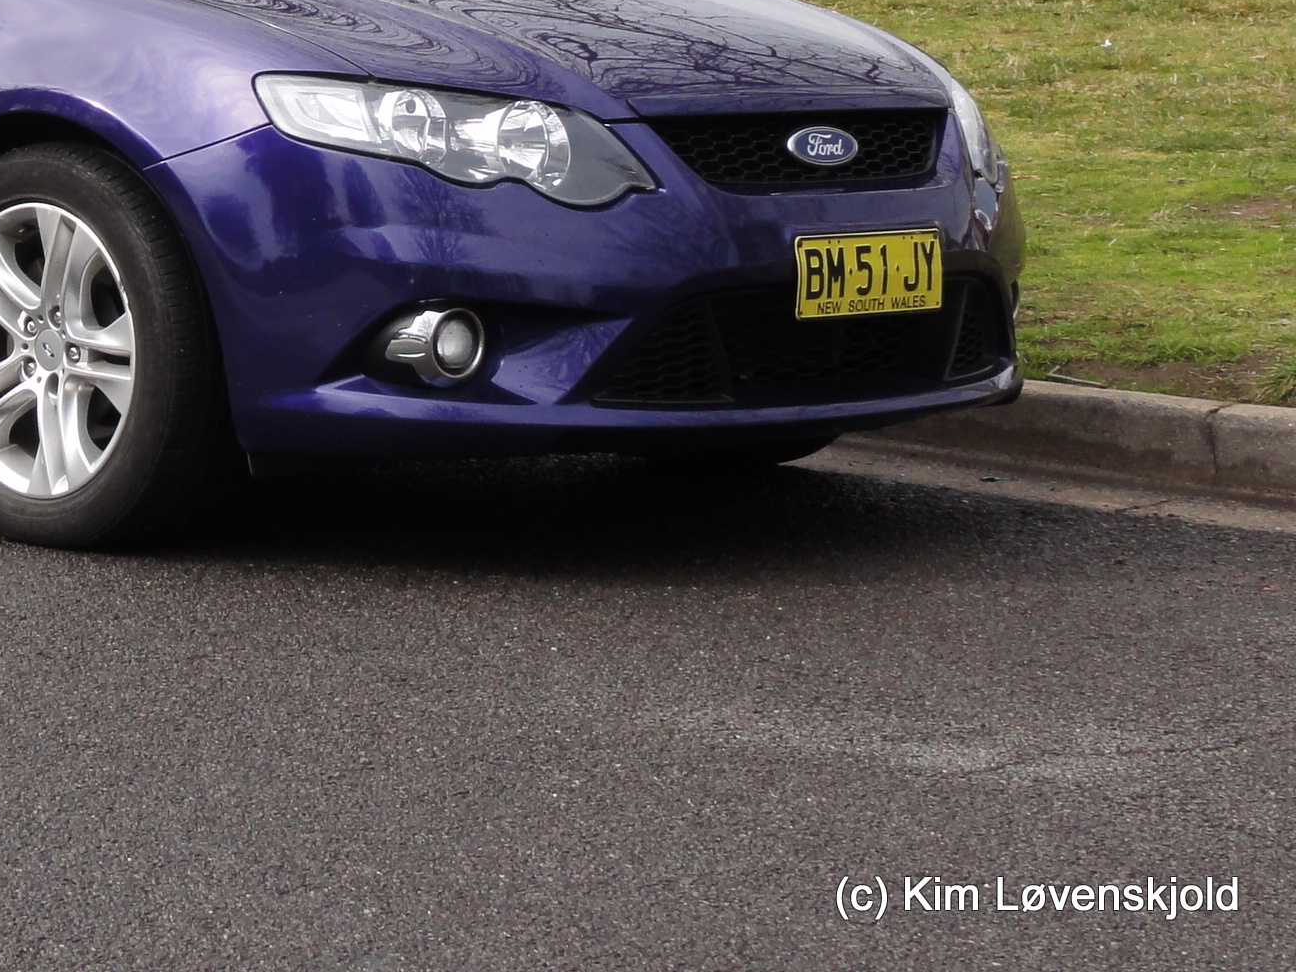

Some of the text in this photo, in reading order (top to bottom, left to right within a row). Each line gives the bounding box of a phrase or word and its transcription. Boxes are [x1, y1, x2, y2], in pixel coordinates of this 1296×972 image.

[807, 133, 844, 156] Ford
[804, 240, 935, 300] BM 51 JY
[817, 295, 926, 315] NEW SOUTH WALES
